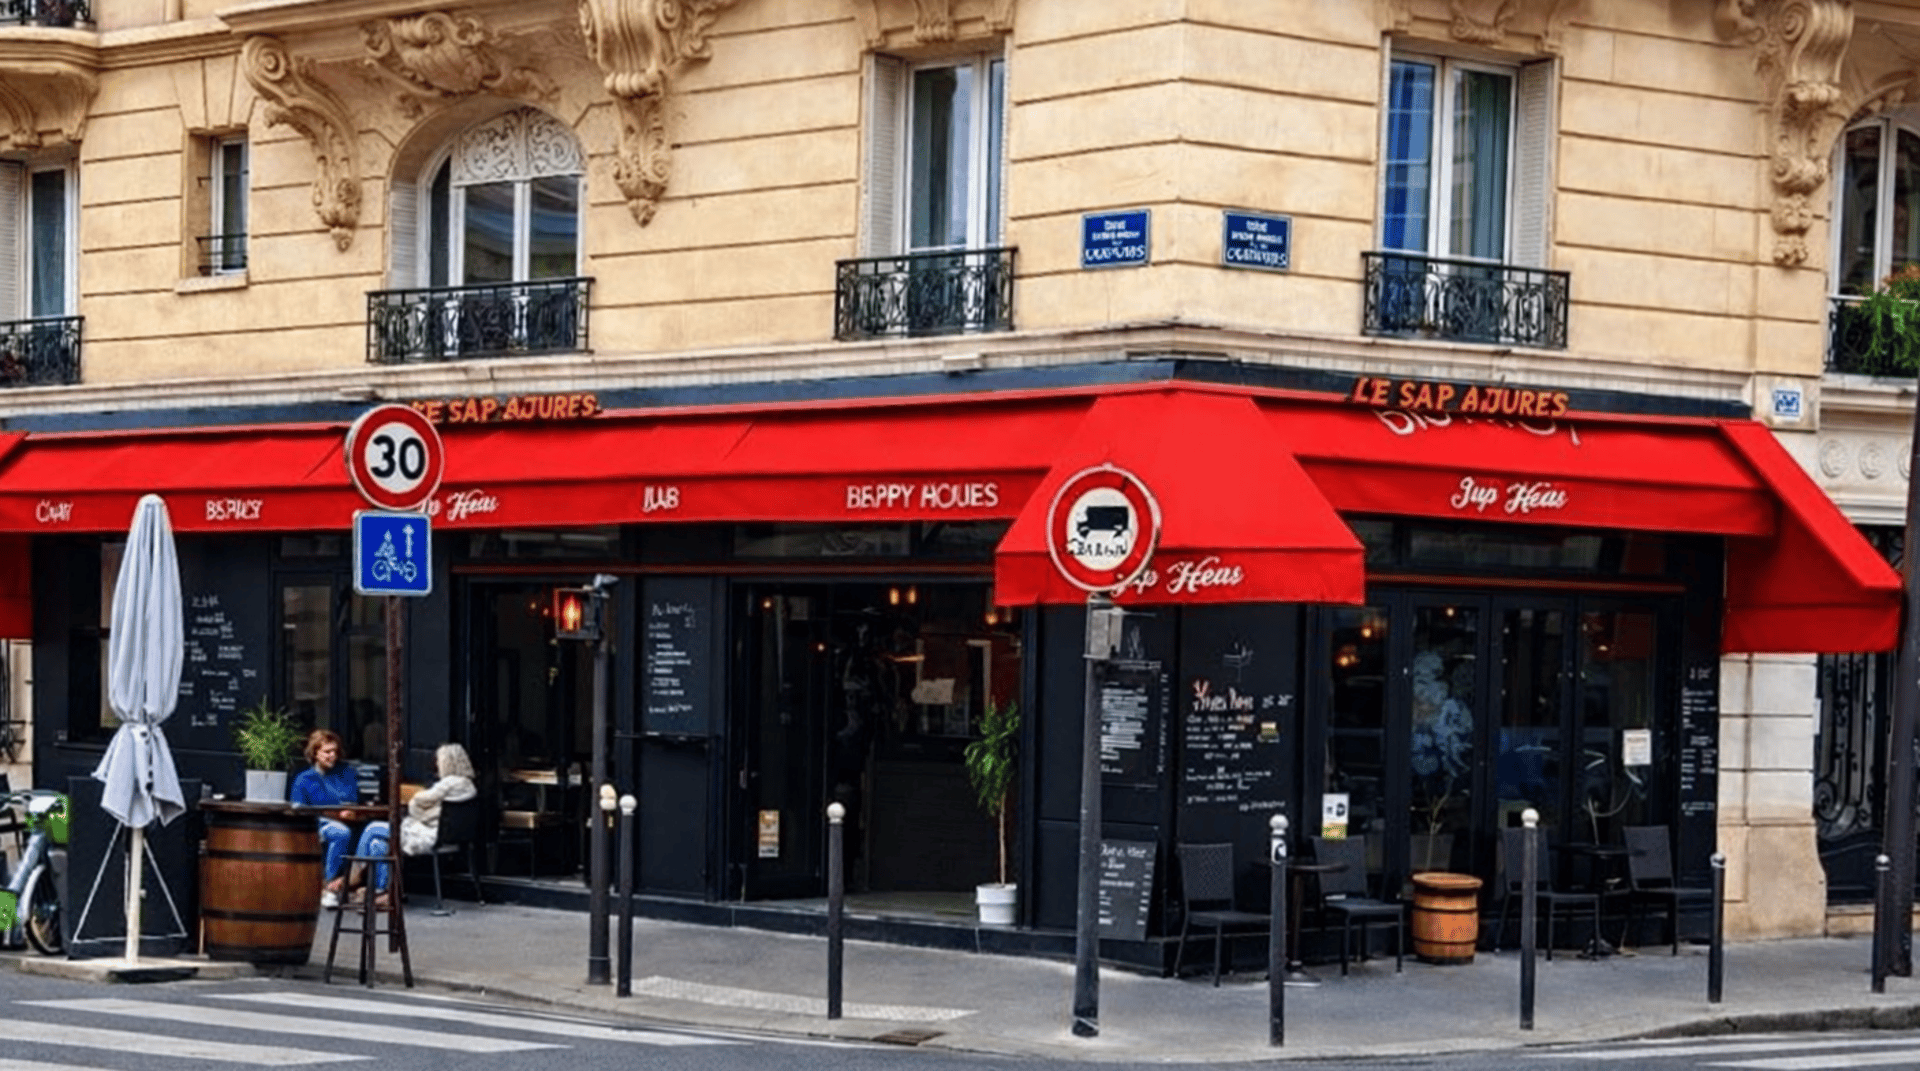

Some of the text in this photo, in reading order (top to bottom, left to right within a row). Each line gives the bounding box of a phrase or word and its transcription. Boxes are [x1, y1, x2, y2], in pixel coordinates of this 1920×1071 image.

[449, 397, 496, 422] SAP
[502, 393, 597, 420] AJURES
[1353, 377, 1391, 406] LE
[1400, 382, 1455, 411] SAP
[371, 434, 427, 481] 30
